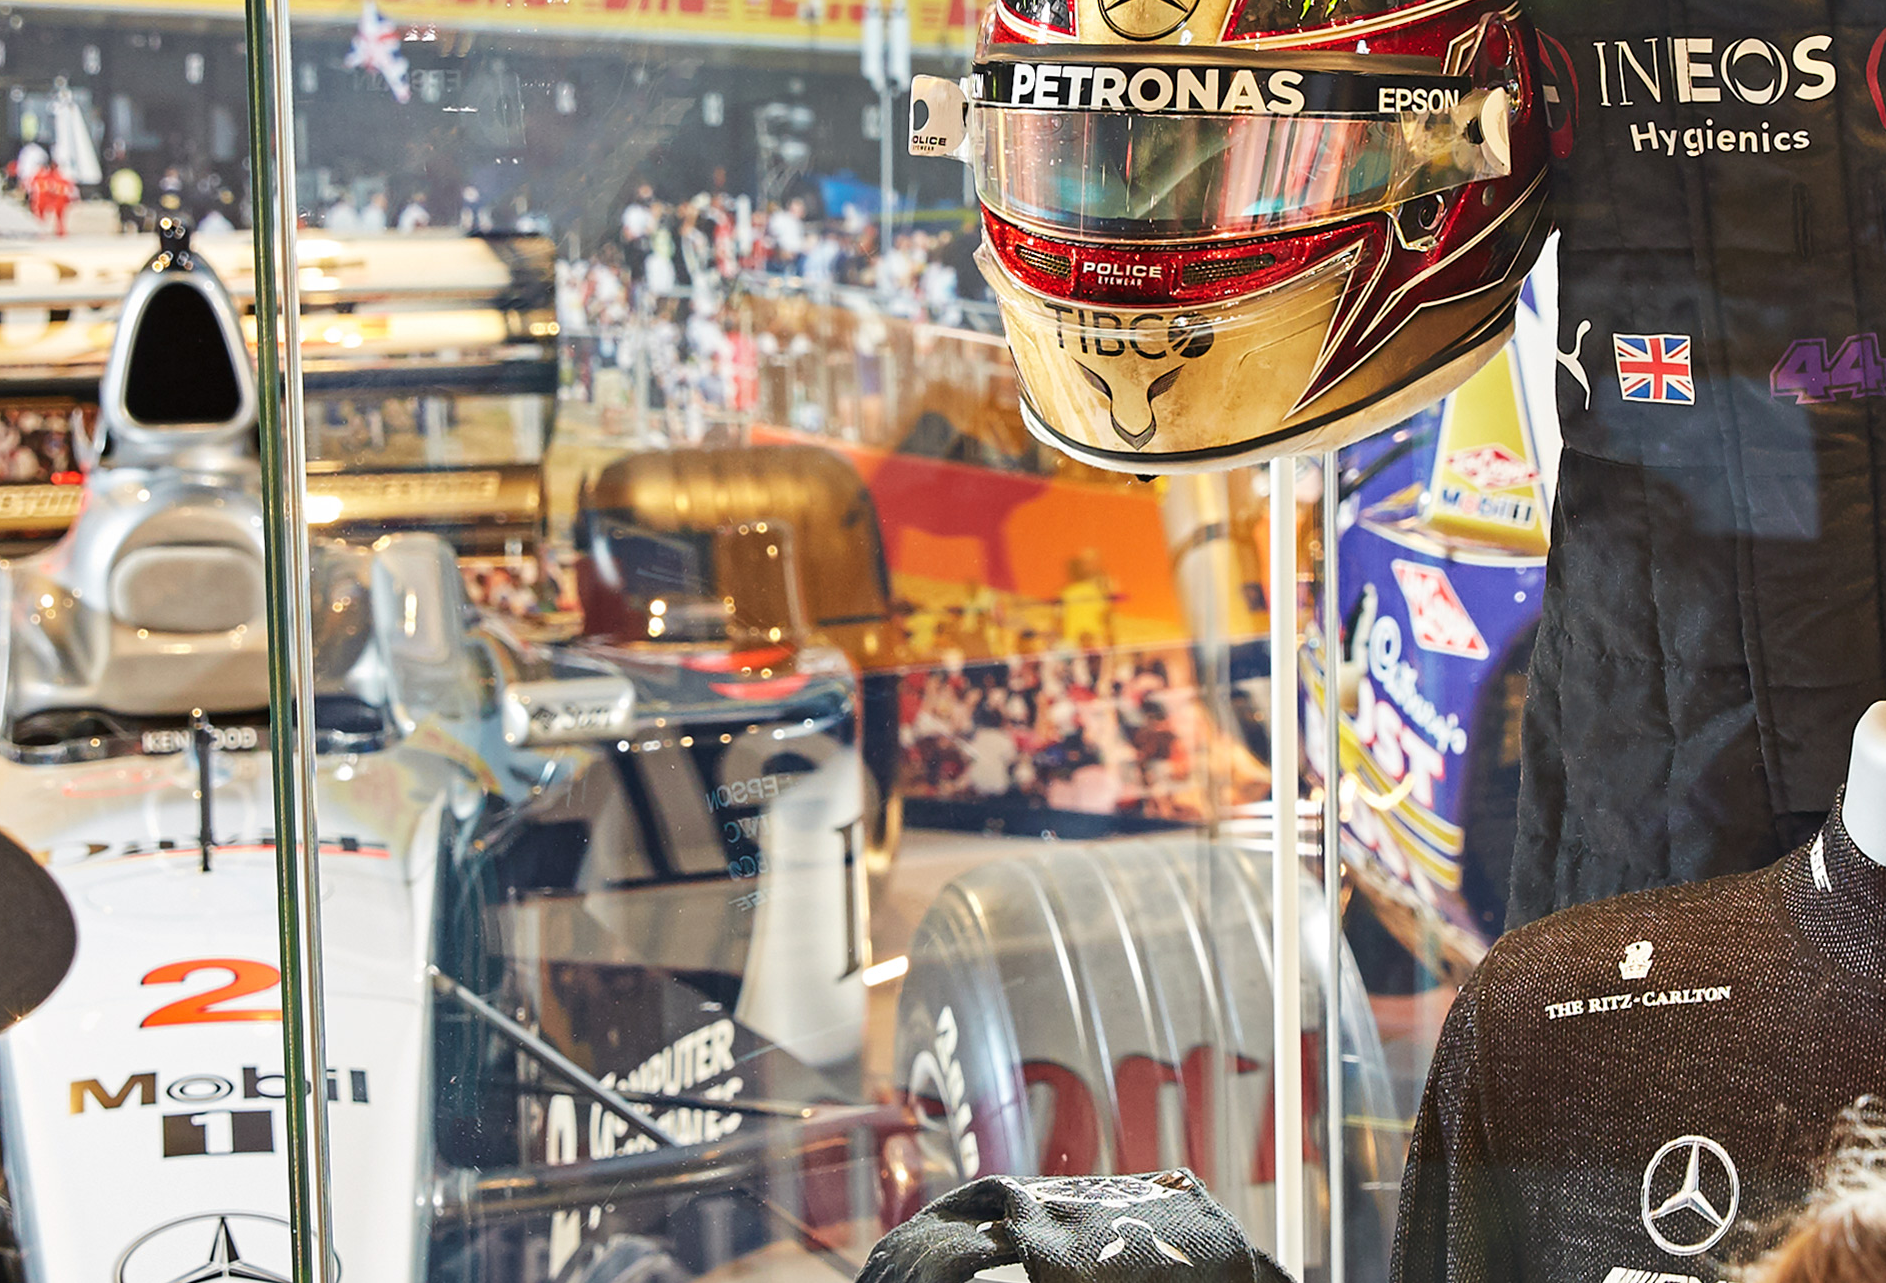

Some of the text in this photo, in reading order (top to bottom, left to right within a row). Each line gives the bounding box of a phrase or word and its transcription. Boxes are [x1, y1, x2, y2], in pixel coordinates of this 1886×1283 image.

[1593, 35, 1836, 106] INEOS
[1011, 63, 1307, 115] PETRONAS
[1378, 88, 1459, 115] EPSON
[912, 135, 947, 146] OLICE
[1629, 119, 1811, 156] Hygienics
[1082, 261, 1163, 279] POLICE
[1097, 276, 1143, 287] EYEWEAR
[1042, 301, 1216, 361] TIBCO
[139, 958, 283, 1028] 2
[1545, 984, 1731, 1020] THE RITZ-CARLTON
